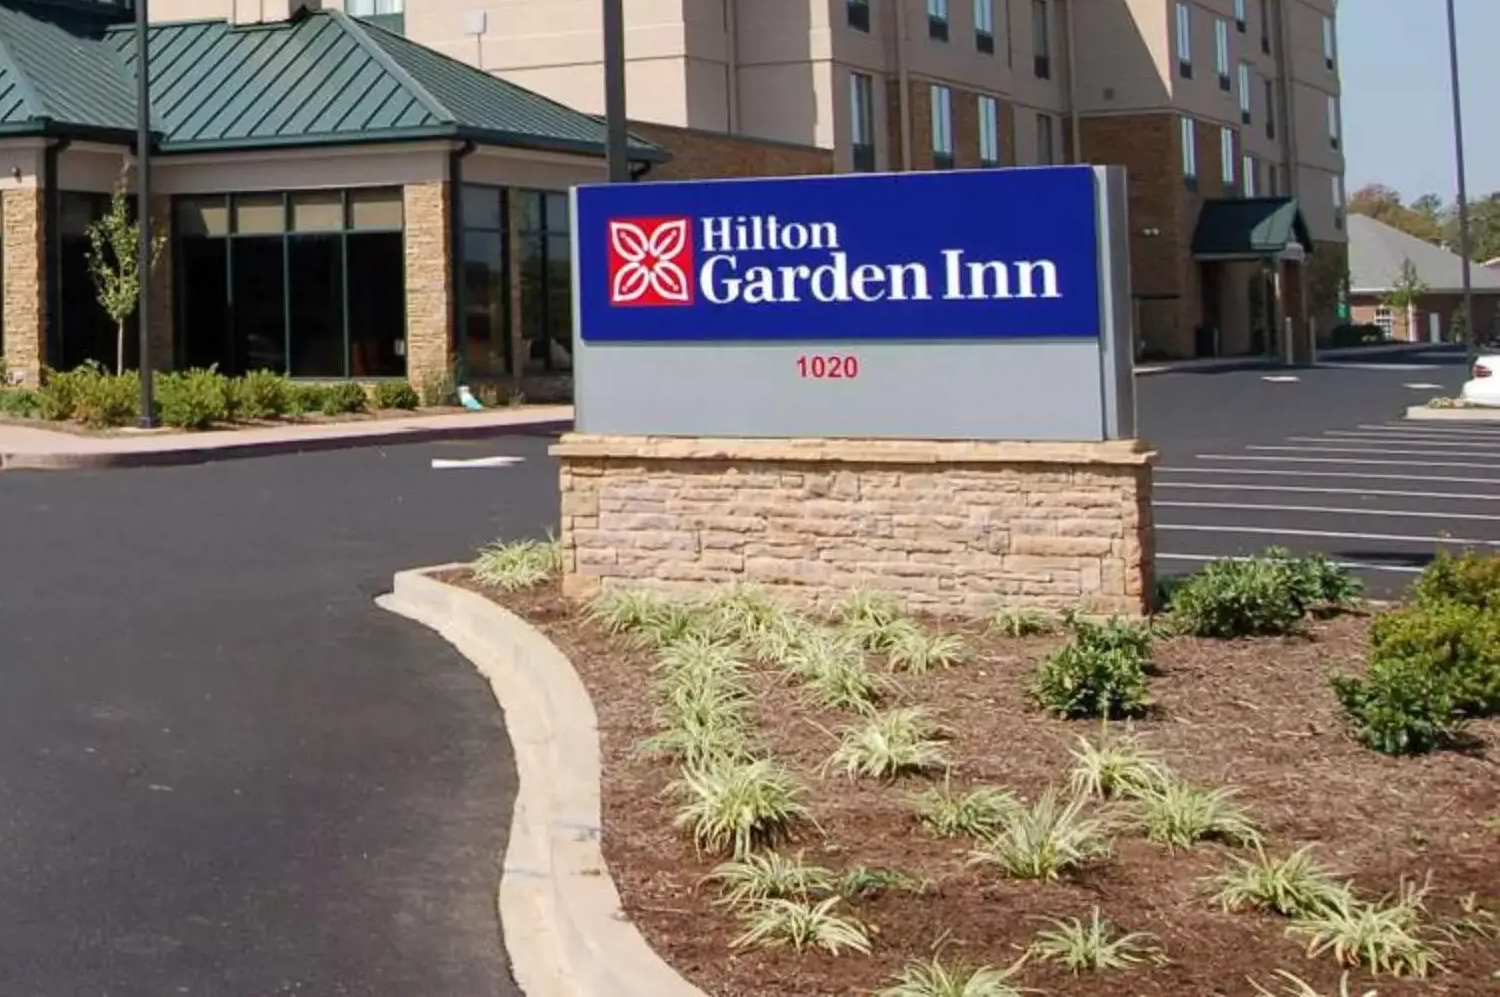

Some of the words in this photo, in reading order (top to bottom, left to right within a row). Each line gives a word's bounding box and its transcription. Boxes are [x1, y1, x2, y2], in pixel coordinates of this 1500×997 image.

[702, 215, 840, 251] Hilton
[700, 252, 933, 304] Garden
[941, 248, 1063, 300] Inn
[796, 356, 858, 379] 1020
